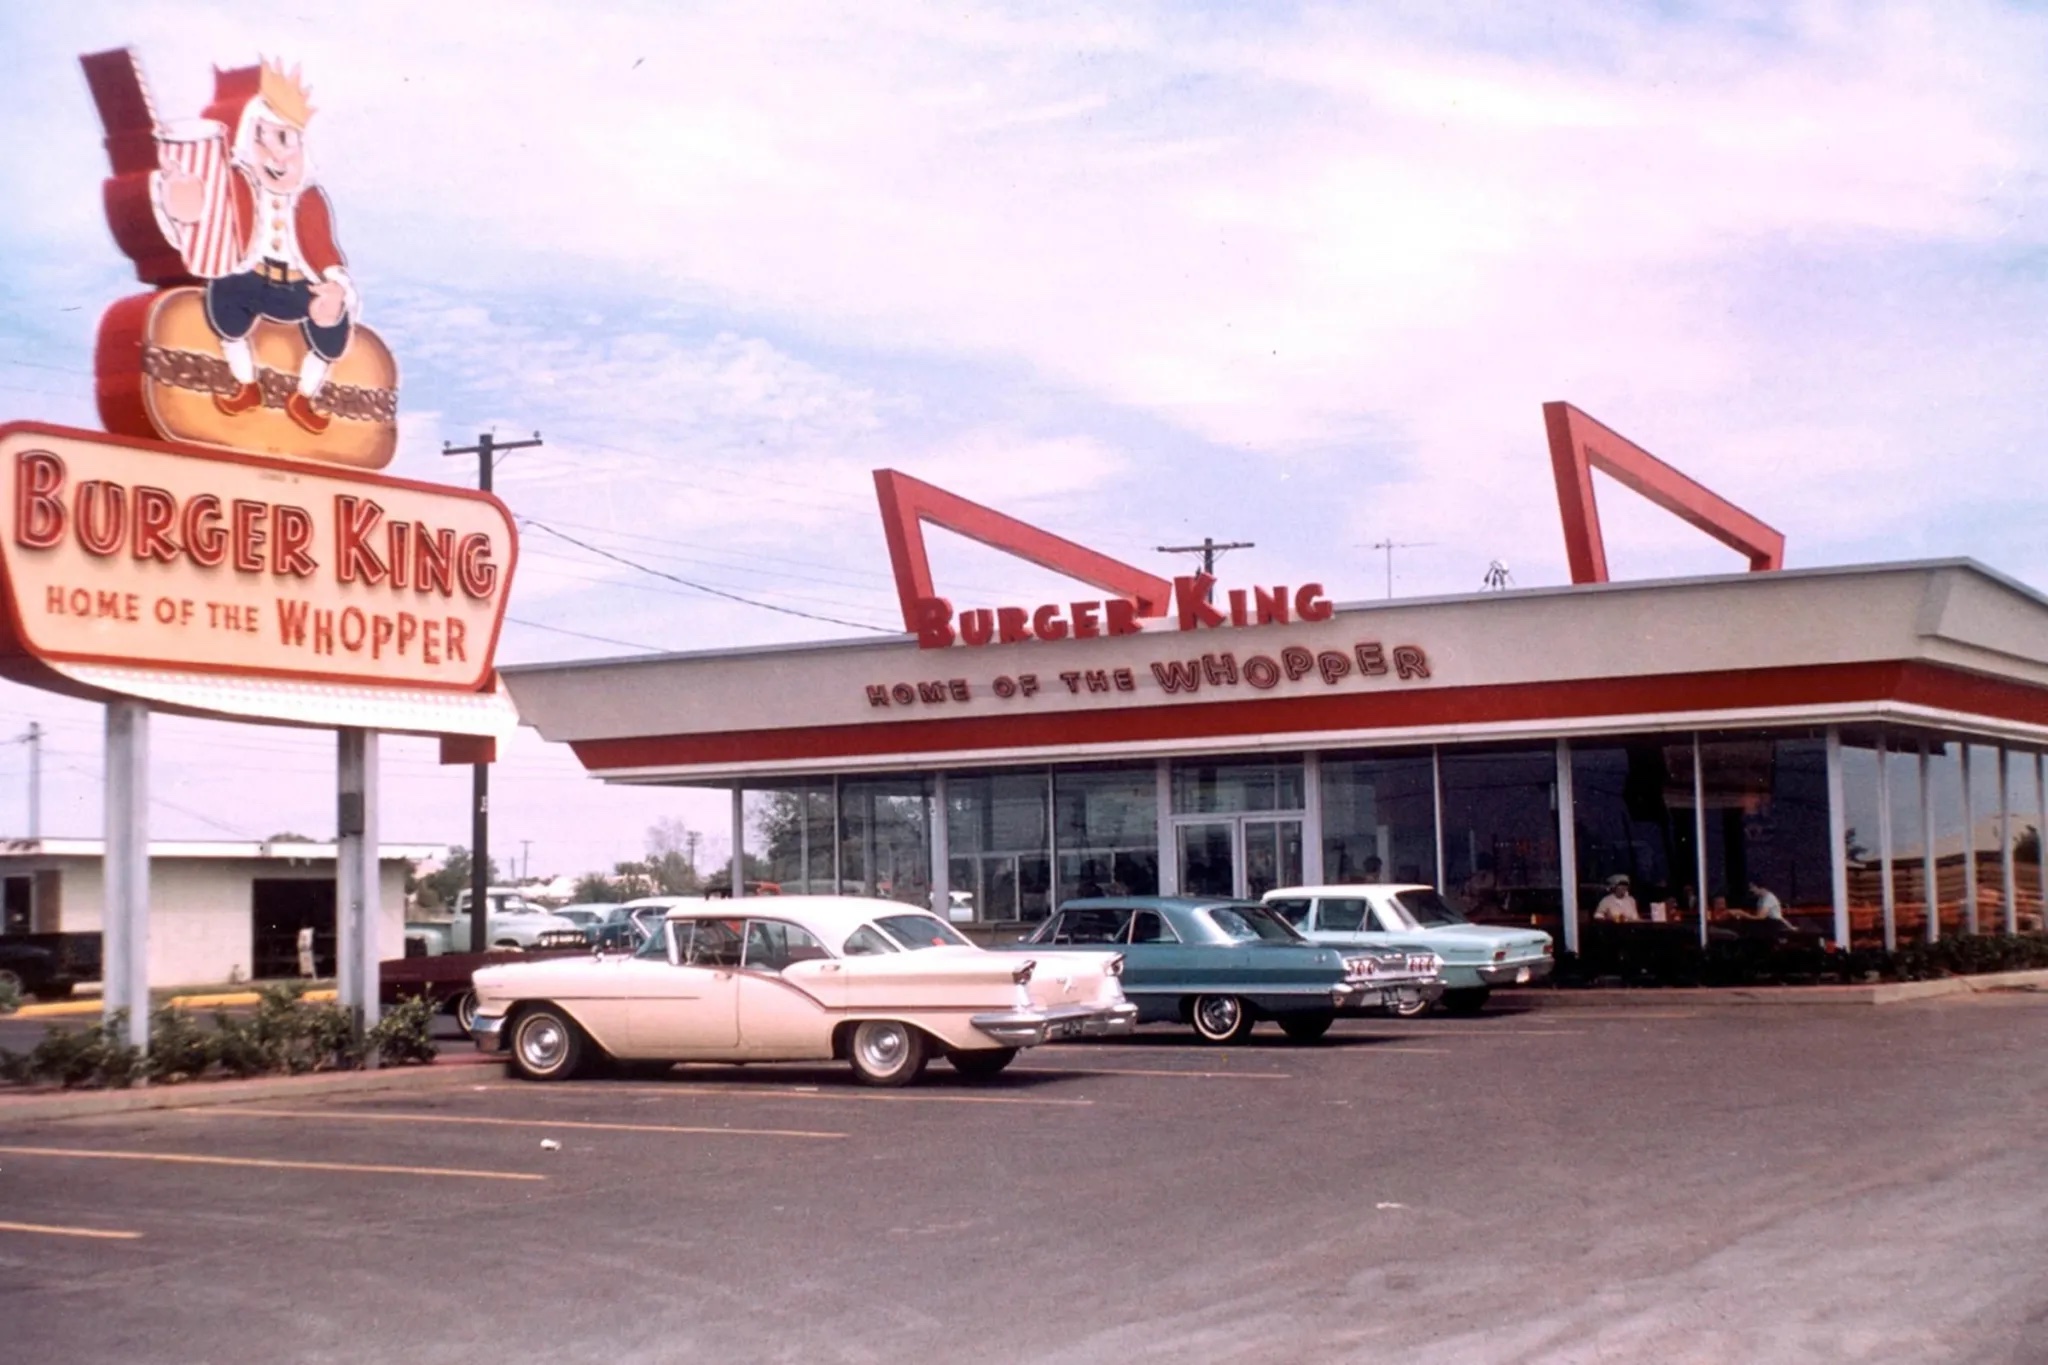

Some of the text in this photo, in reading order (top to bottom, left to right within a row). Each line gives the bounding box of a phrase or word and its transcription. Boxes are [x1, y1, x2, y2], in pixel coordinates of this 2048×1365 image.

[15, 449, 497, 599] BURGER KING
[46, 585, 467, 664] HOME OF THE WHOPPER
[918, 572, 1333, 649] BURGER KING
[866, 642, 1430, 707] HOME OF THE WHOPPER
